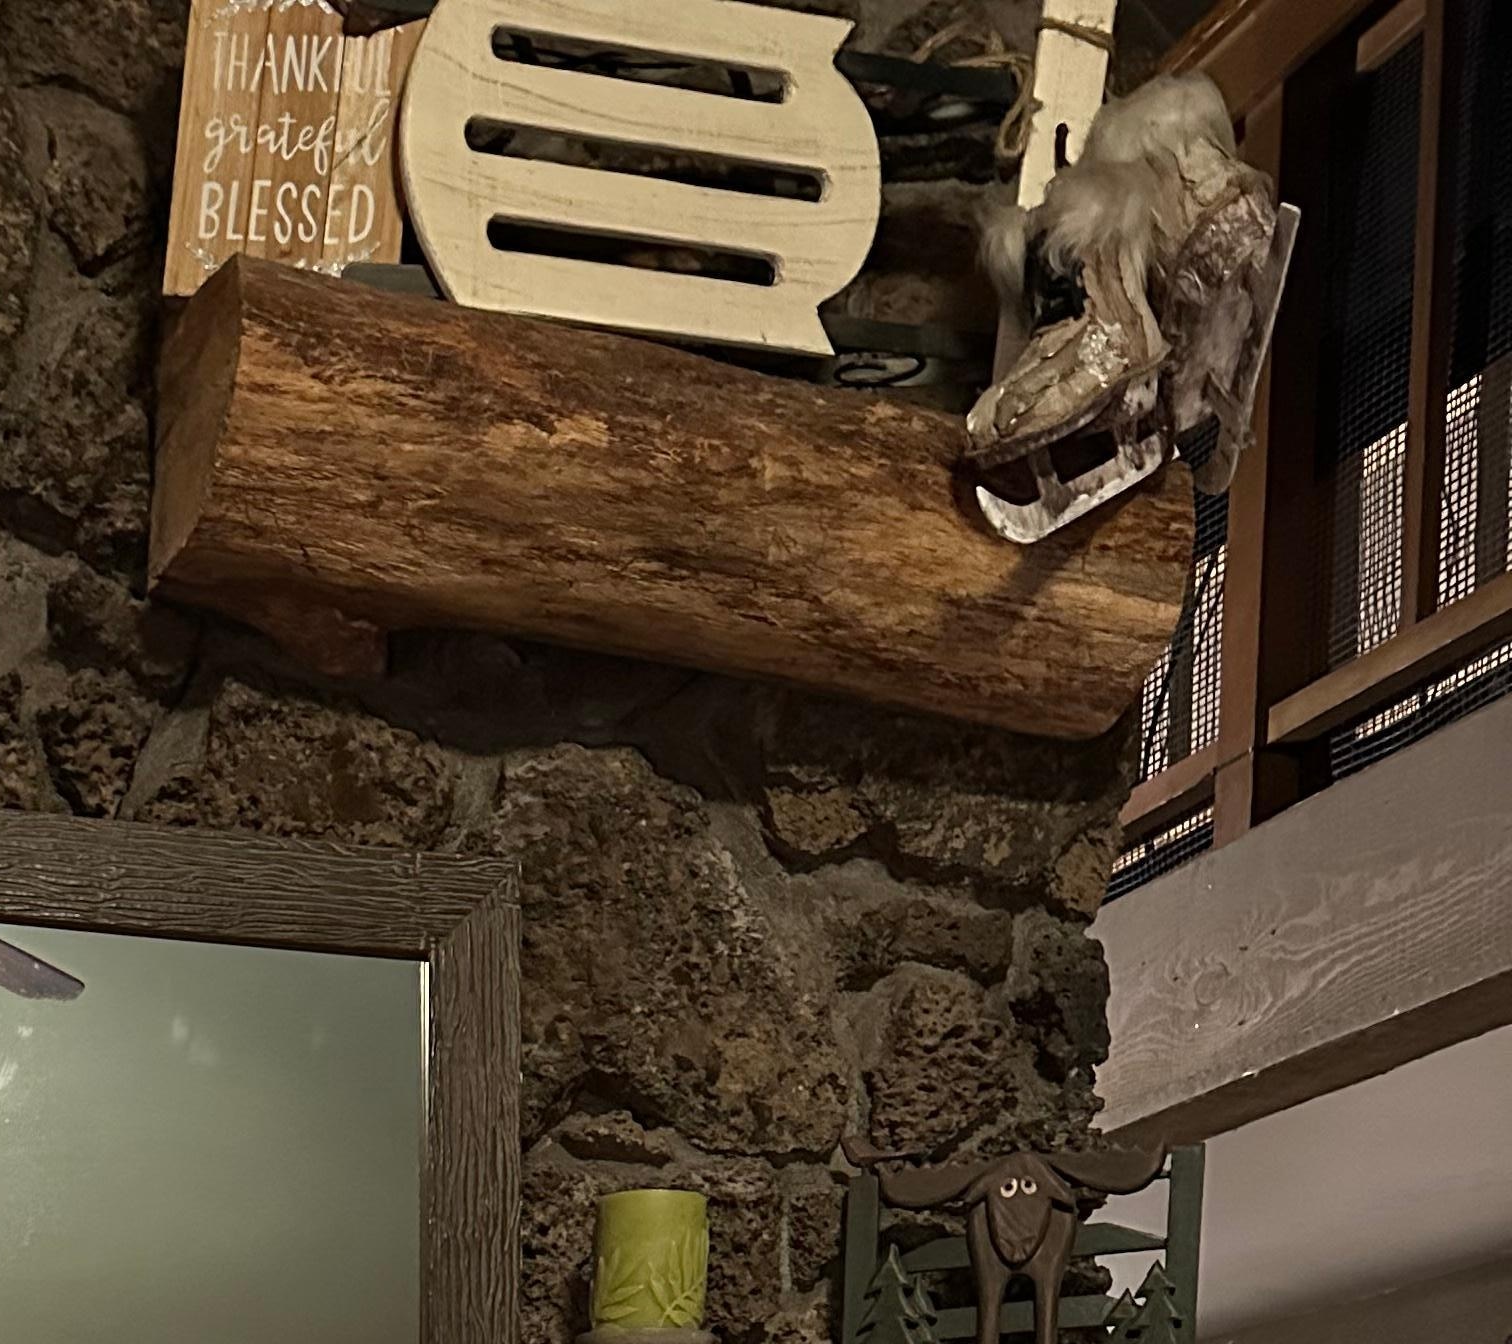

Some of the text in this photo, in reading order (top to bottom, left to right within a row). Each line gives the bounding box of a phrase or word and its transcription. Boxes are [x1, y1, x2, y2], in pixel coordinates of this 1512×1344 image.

[214, 30, 391, 97] THANKFUL
[203, 98, 390, 176] grateful
[198, 179, 376, 245] BLESSED
